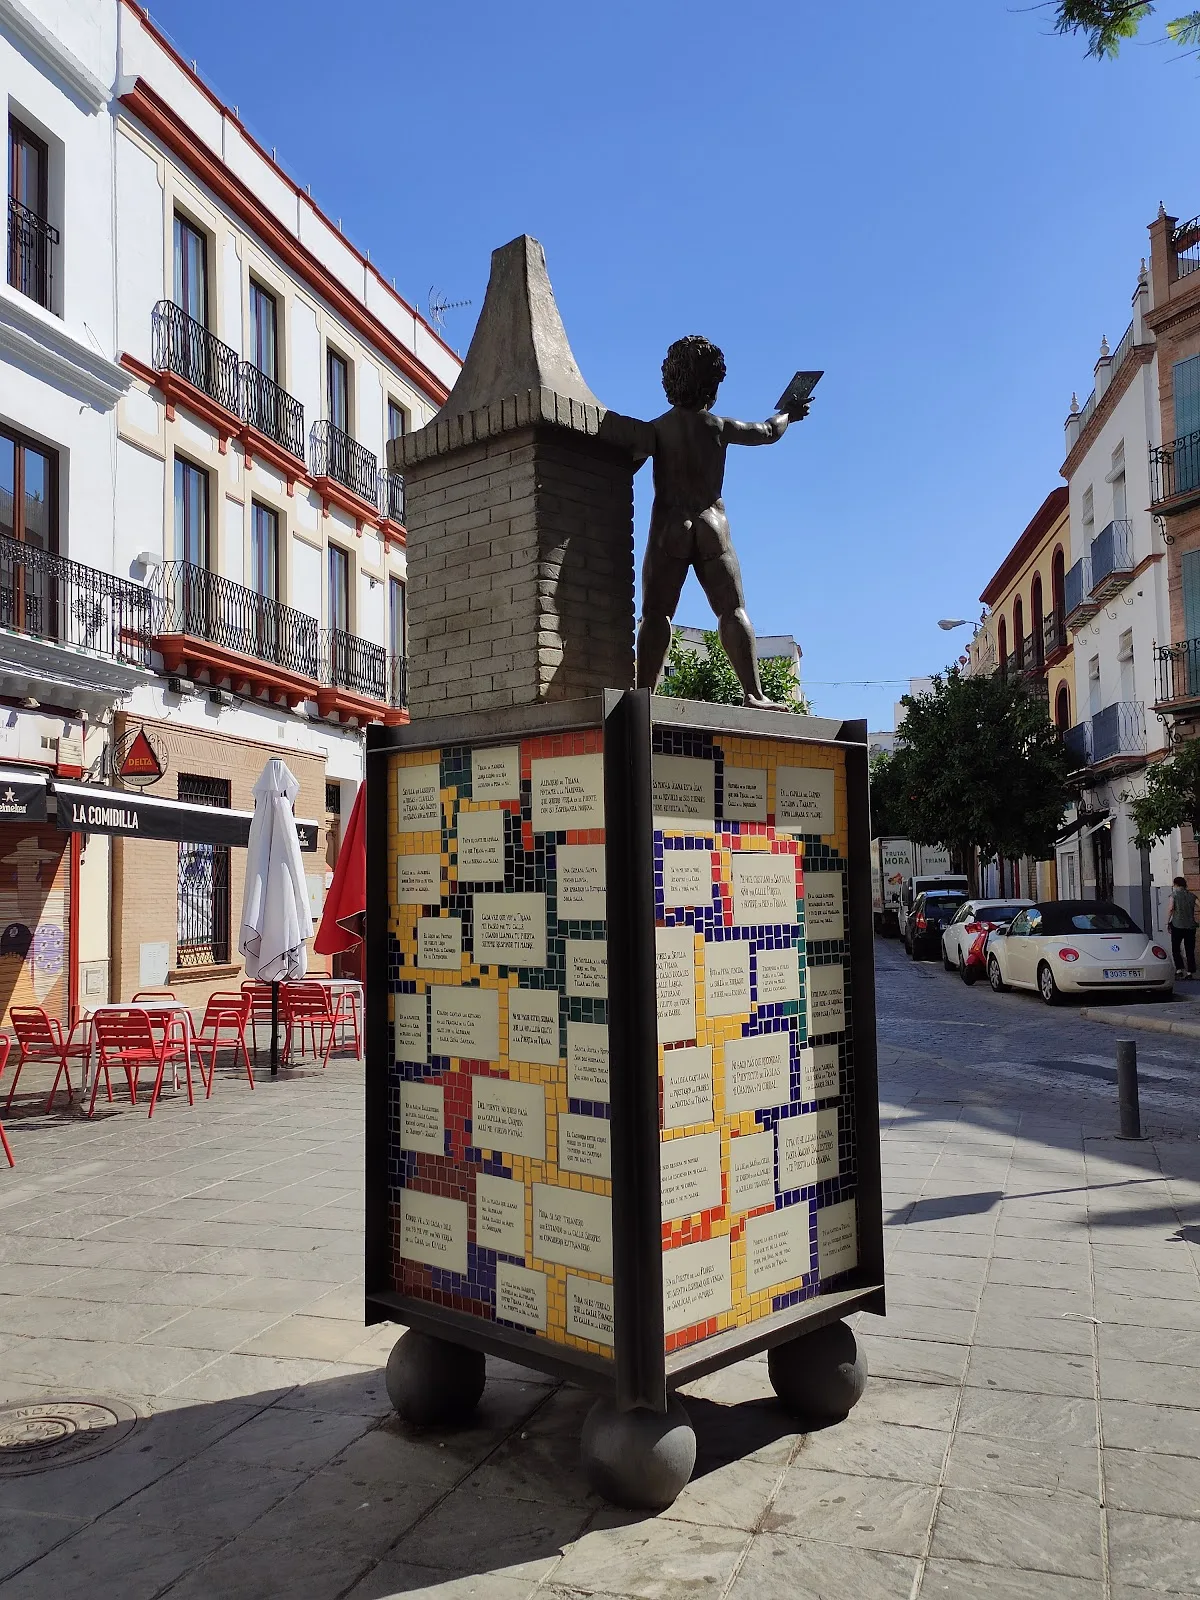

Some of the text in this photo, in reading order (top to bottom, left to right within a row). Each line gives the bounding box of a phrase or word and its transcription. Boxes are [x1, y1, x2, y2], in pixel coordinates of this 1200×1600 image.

[129, 758, 152, 766] DELTA
[564, 776, 579, 785] TRIANA
[73, 803, 139, 830] LA COMIDILLA
[884, 857, 910, 865] MORA
[754, 887, 766, 896] CALLE
[517, 912, 532, 922] TRIANA
[572, 1229, 585, 1239] CALLE
